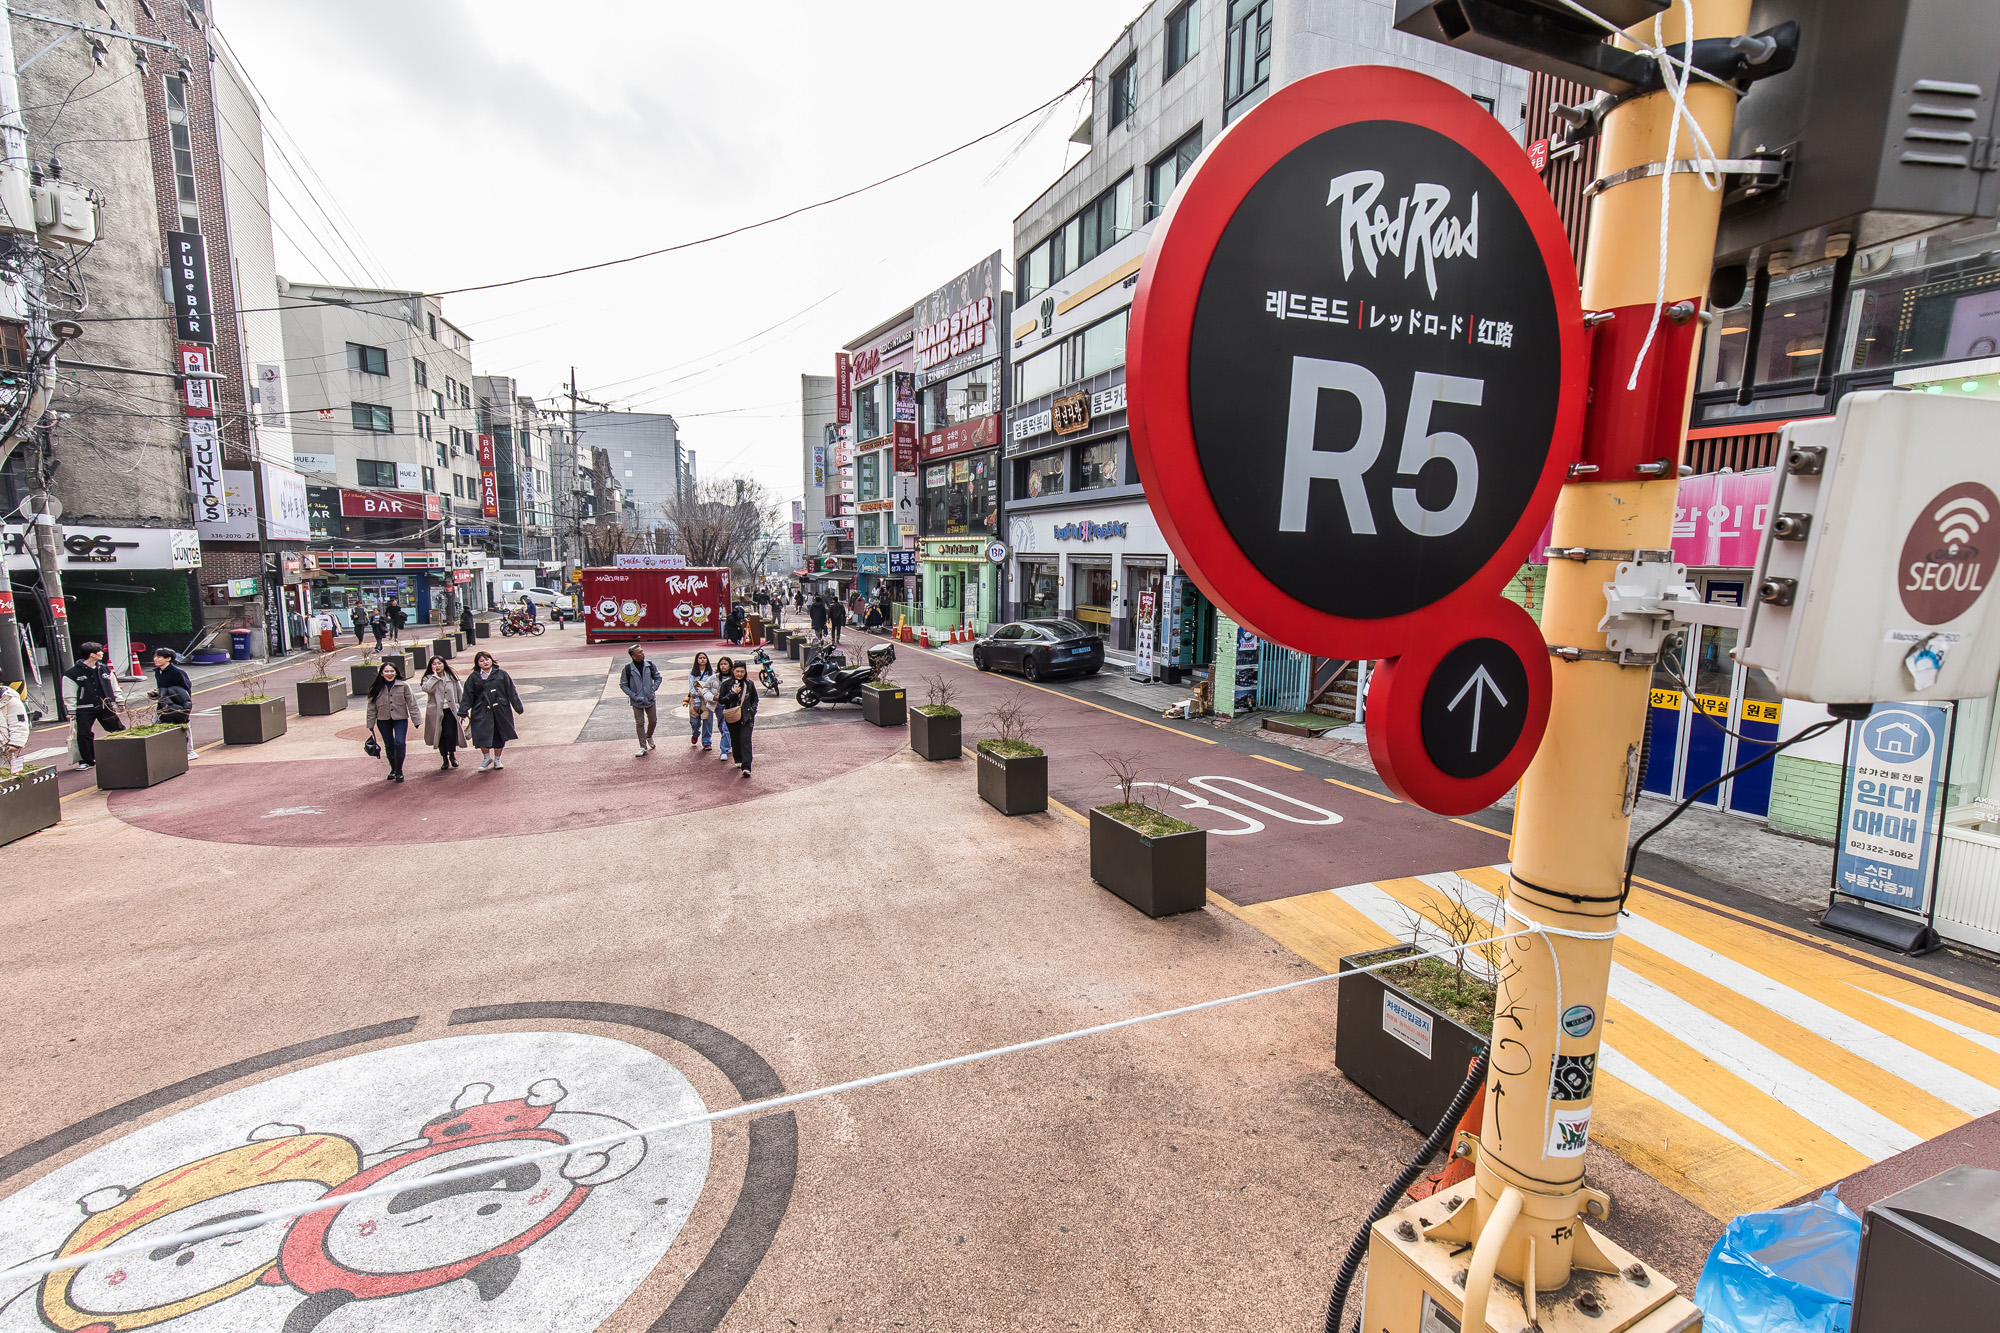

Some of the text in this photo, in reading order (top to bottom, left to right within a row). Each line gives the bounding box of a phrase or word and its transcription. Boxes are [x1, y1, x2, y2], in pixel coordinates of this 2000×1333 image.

[1326, 170, 1479, 300] Red Road
[180, 242, 195, 280] PUB
[187, 295, 201, 332] BAR
[1265, 290, 1349, 324] 레드로드
[917, 296, 992, 353] MAID STAR
[1477, 318, 1514, 348] 红路
[921, 322, 986, 370] MAID CAFE
[482, 439, 490, 460] BAR
[1279, 355, 1484, 537] R5
[195, 439, 220, 520] JUNTOS
[484, 477, 495, 506] BAR
[308, 510, 331, 519] AR
[364, 499, 403, 513] BAR
[173, 547, 200, 565] JUNTOS
[991, 547, 1004, 558] BR
[1905, 562, 1983, 592] SEOUL
[1652, 692, 1679, 706] 상가
[1746, 704, 1778, 719] 원룸
[1858, 766, 1924, 784] 상가건물전문
[1857, 780, 1922, 814] 임대
[1852, 809, 1918, 844] 매매
[1850, 840, 1914, 861] 02)322-3062
[1844, 871, 1914, 899] 부동산중개
[1864, 864, 1894, 881] 스타
[1386, 999, 1429, 1032] 차량진입금지
